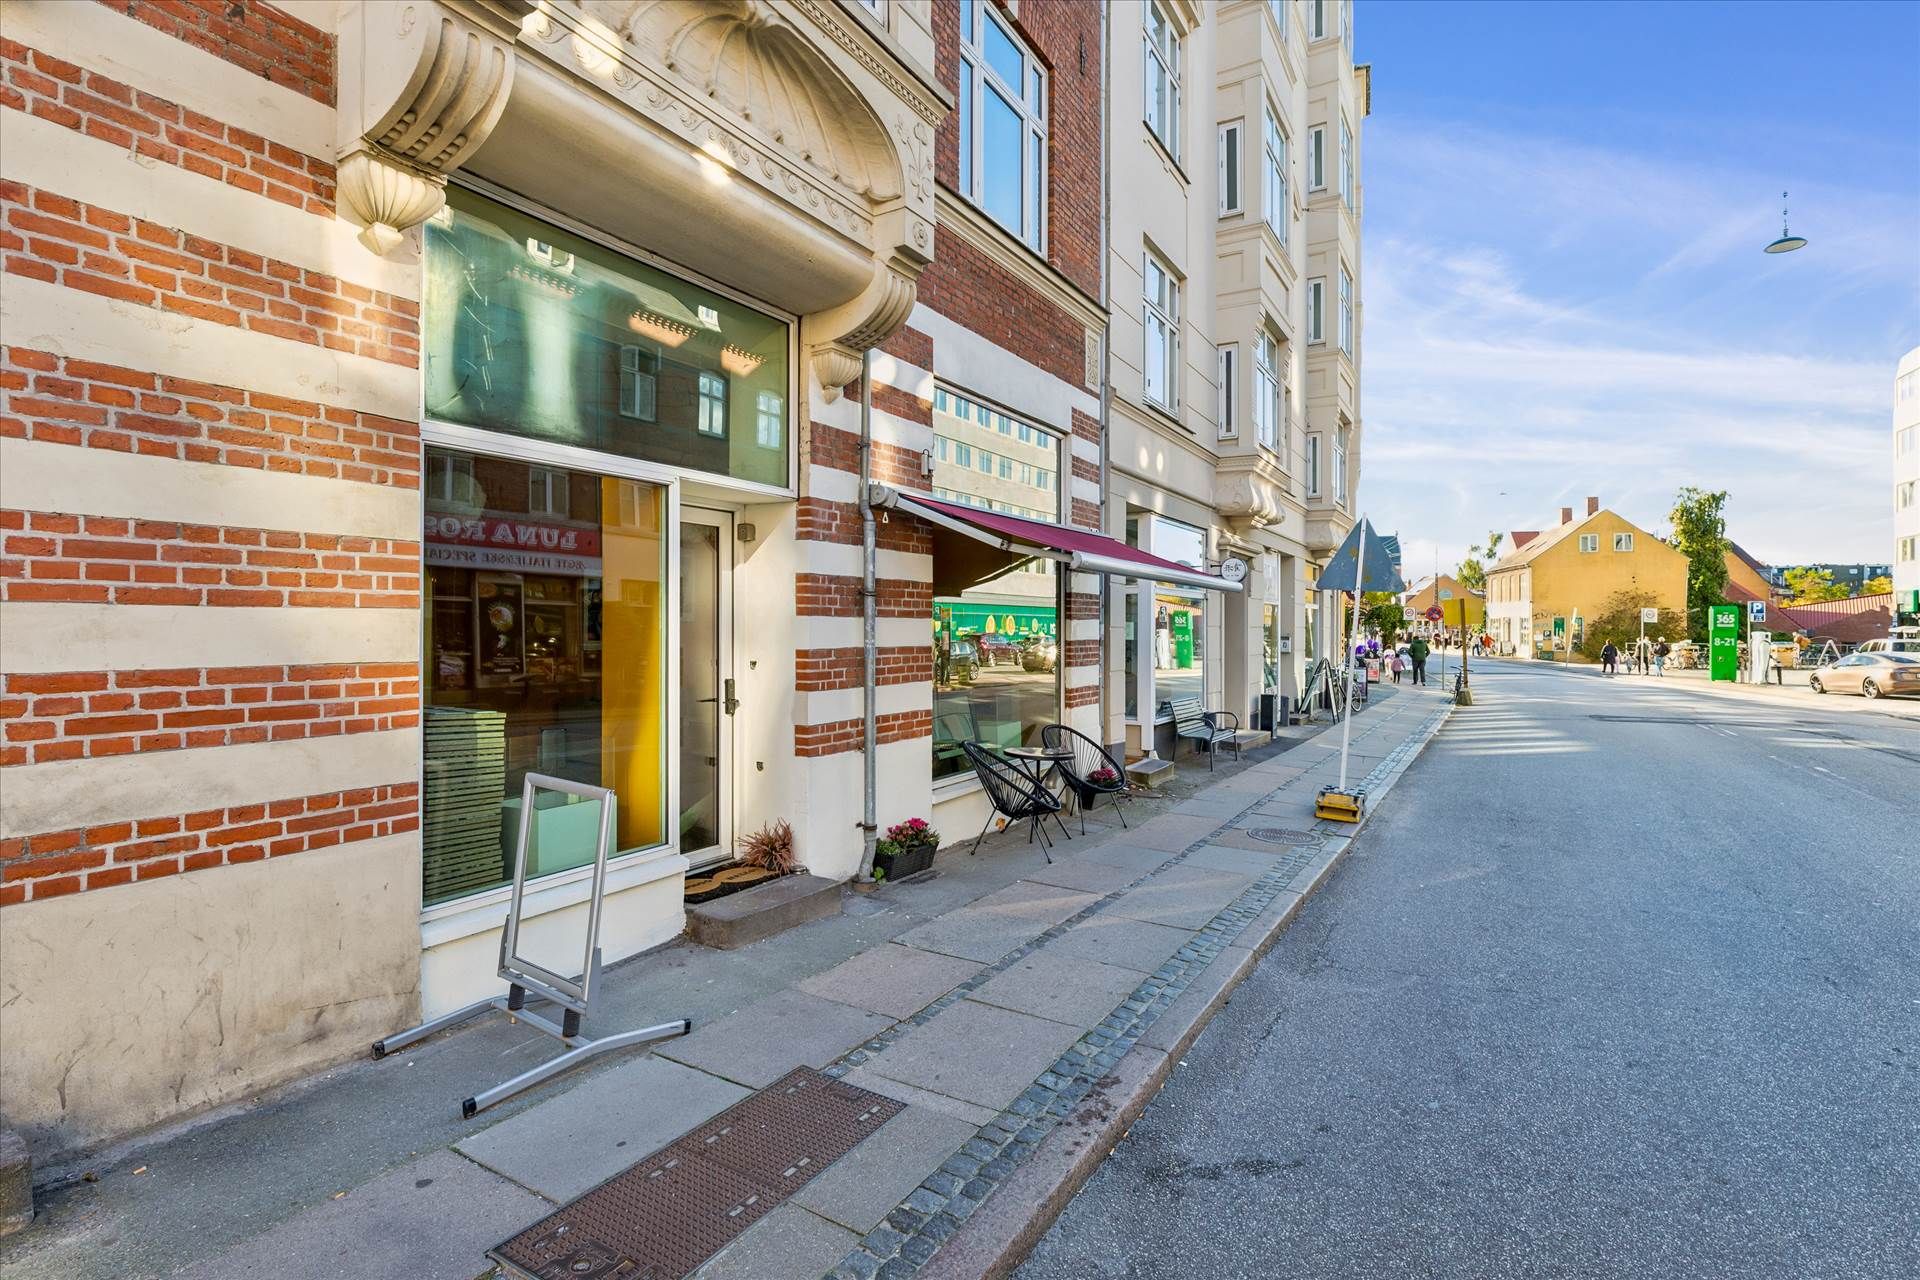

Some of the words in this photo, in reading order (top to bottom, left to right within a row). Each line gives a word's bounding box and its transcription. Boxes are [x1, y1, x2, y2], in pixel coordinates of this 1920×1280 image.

[1753, 602, 1762, 612] P
[1716, 614, 1735, 623] 365
[1714, 637, 1735, 646] 8-21
